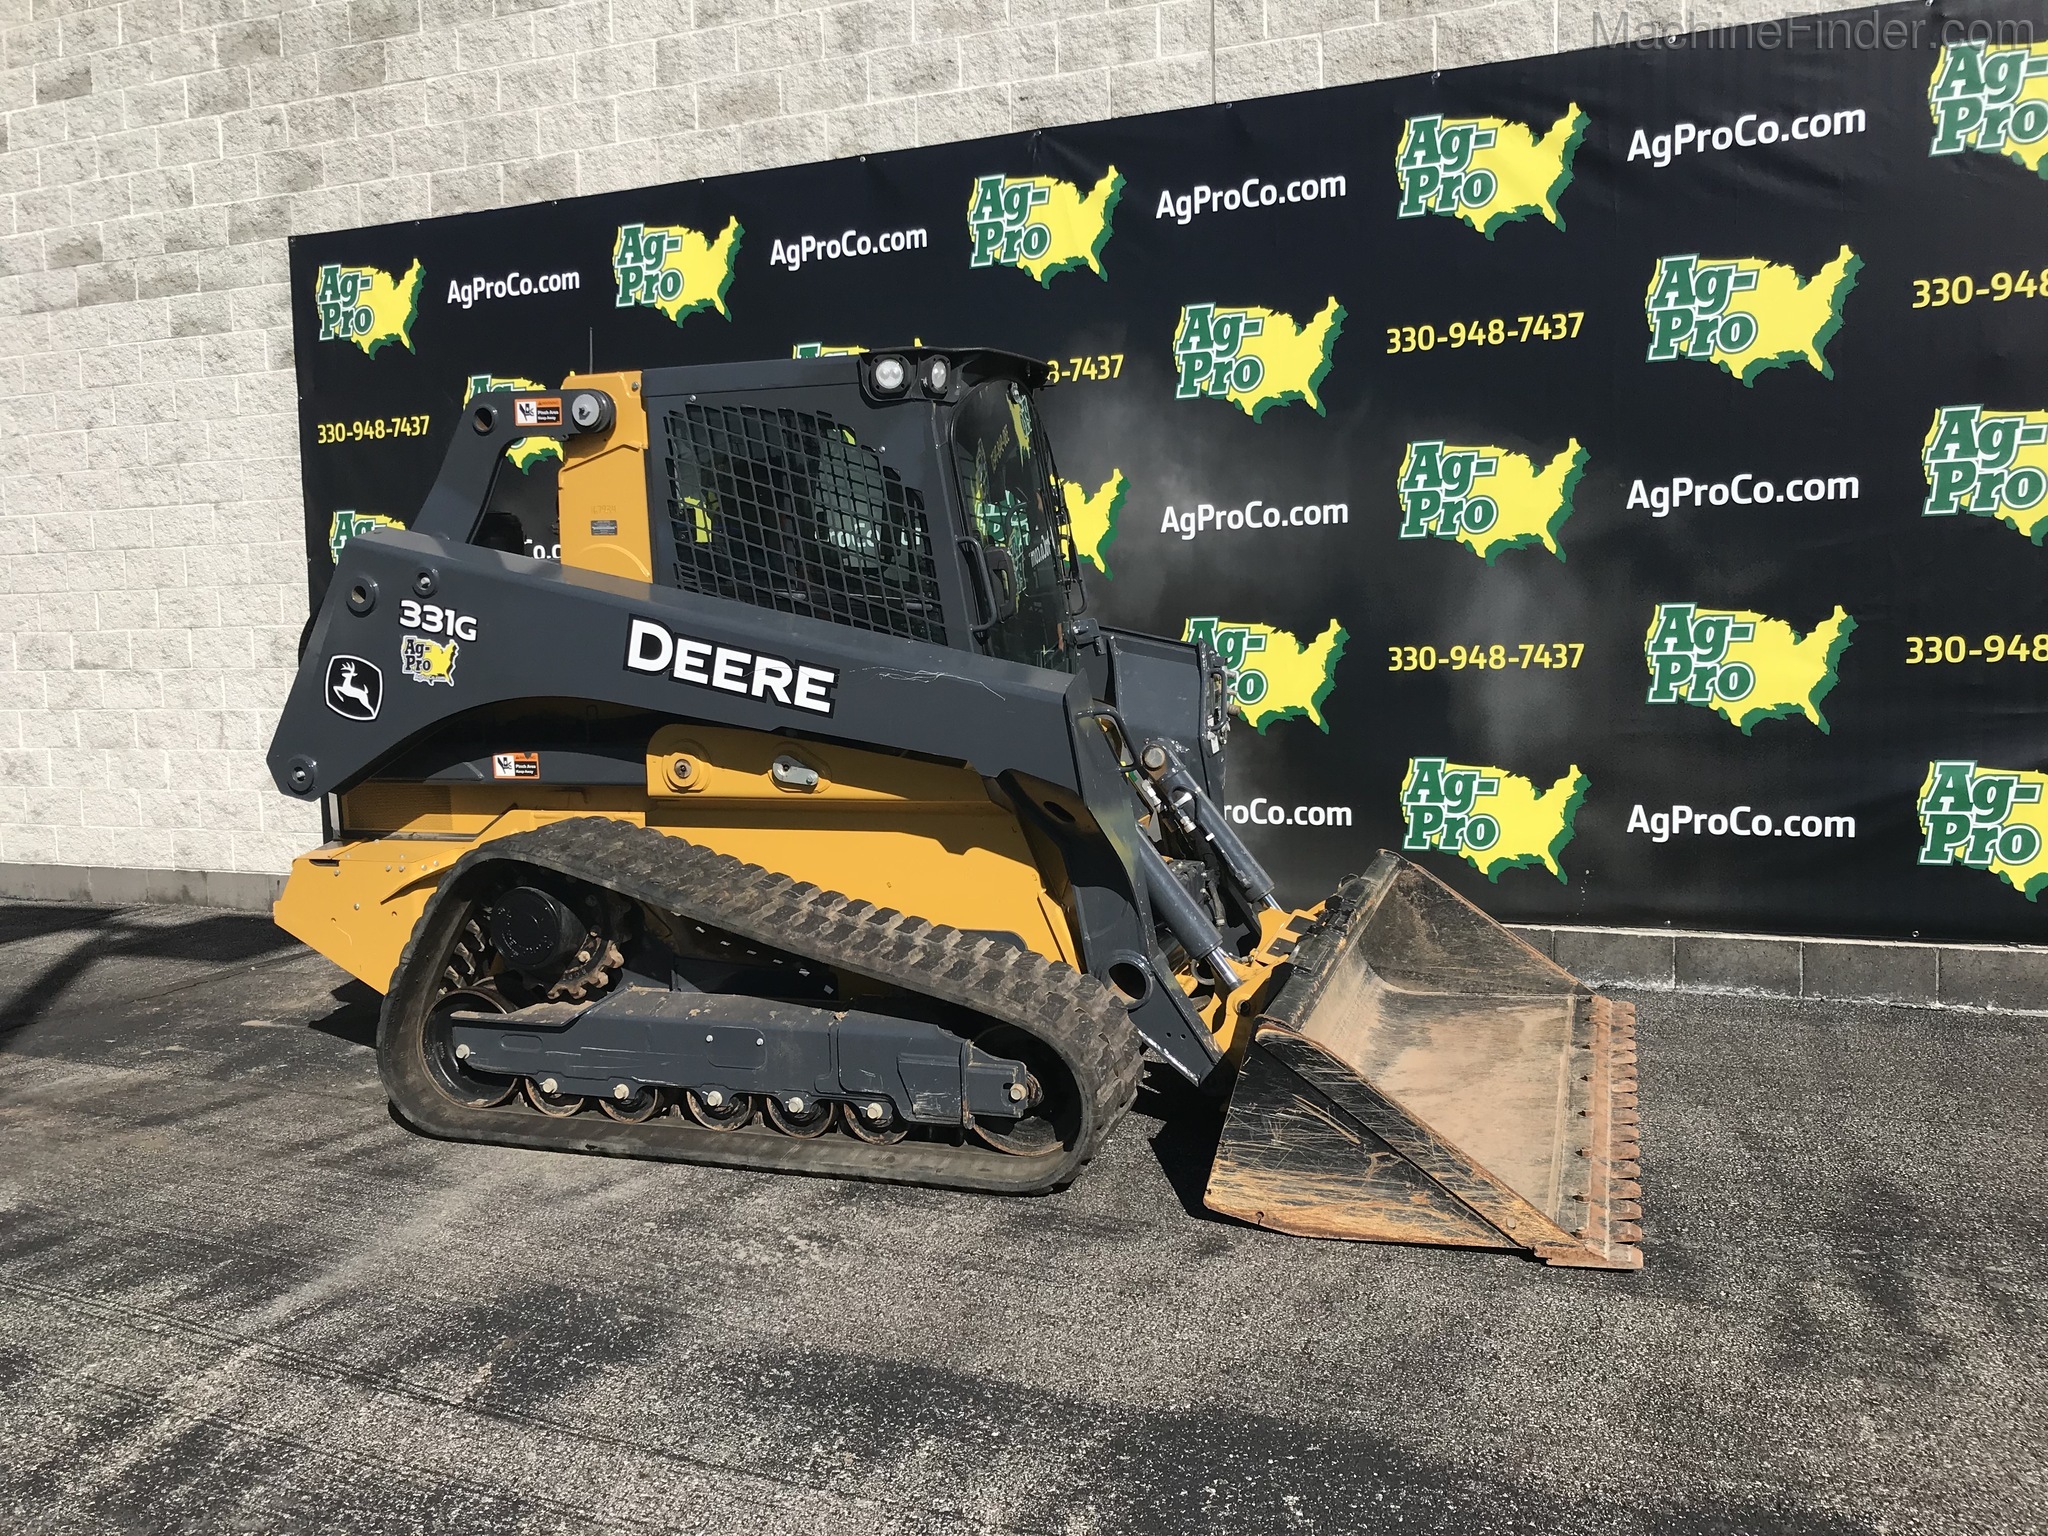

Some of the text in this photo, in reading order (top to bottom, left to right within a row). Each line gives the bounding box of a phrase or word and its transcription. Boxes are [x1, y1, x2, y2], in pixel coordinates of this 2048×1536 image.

[1932, 40, 2048, 108] Ag-
[1400, 115, 1495, 172] Ag-
[1627, 109, 1865, 167] AgProCo.com
[1931, 97, 2048, 154] Pro
[971, 175, 1049, 227] Ag-
[1156, 176, 1346, 224] AgProCo.com
[1399, 164, 1496, 217] Pro
[615, 225, 681, 271] Ag-
[770, 229, 927, 272] AgProCo.com
[970, 221, 1050, 267] Pro
[318, 264, 372, 306] Ag-
[448, 271, 580, 309] AgProCo.com
[615, 265, 682, 307] Pro
[1649, 254, 1758, 315] Ag-
[319, 301, 373, 340] Pro
[1176, 303, 1265, 356] Ag-
[1387, 312, 1585, 354] 330-948-7437
[1647, 306, 1758, 361] Pro
[1047, 353, 1124, 384] 8-7437
[1175, 347, 1264, 398] Pro
[317, 415, 430, 443] 330-948-7437
[1925, 406, 2048, 472] Ag-
[1401, 440, 1498, 495] Ag-
[1924, 460, 2047, 514] Pro
[1400, 485, 1498, 538] Pro
[1626, 474, 1859, 517] AgProCo.com
[1161, 500, 1349, 540] AgProCo.com
[400, 600, 477, 641] 331G
[1650, 604, 1755, 663] Ag-
[404, 638, 430, 658] Ag-
[405, 655, 431, 671] Pro
[628, 619, 836, 713] DEERE
[1388, 642, 1585, 671] 330-948-7437
[1647, 654, 1754, 702] Pro
[1404, 758, 1498, 813] Ag-
[1920, 761, 2042, 826] Ag-
[1224, 797, 1353, 827] roCo.com
[1403, 802, 1499, 850] Pro
[1627, 805, 1856, 842] AgProCo.com
[1919, 812, 2041, 864] Pro
